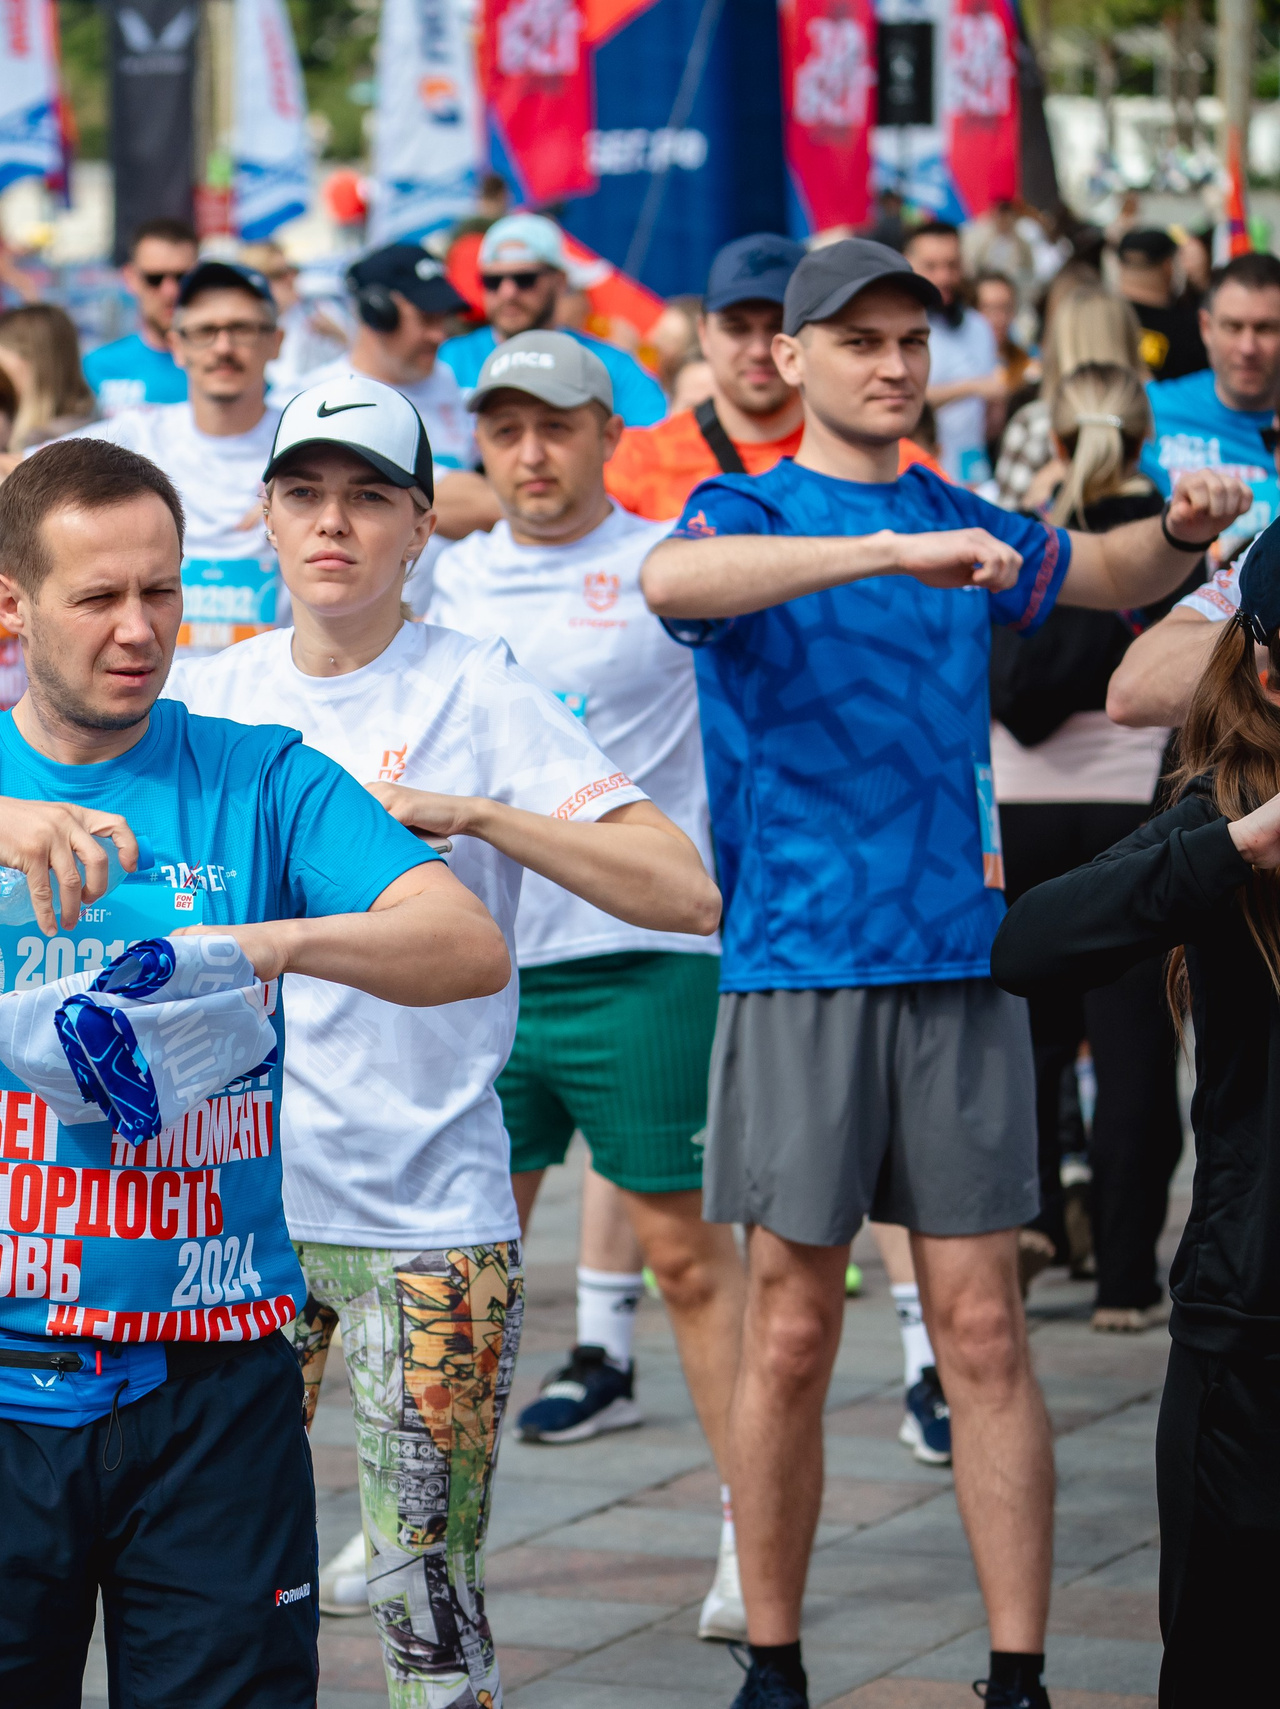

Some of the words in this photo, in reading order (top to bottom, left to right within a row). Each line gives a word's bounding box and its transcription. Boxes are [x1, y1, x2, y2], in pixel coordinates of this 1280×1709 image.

[176, 894, 192, 902] FON
[176, 901, 192, 909] BET
[172, 1233, 262, 1307] 2024
[275, 1583, 310, 1607] FORWARD
